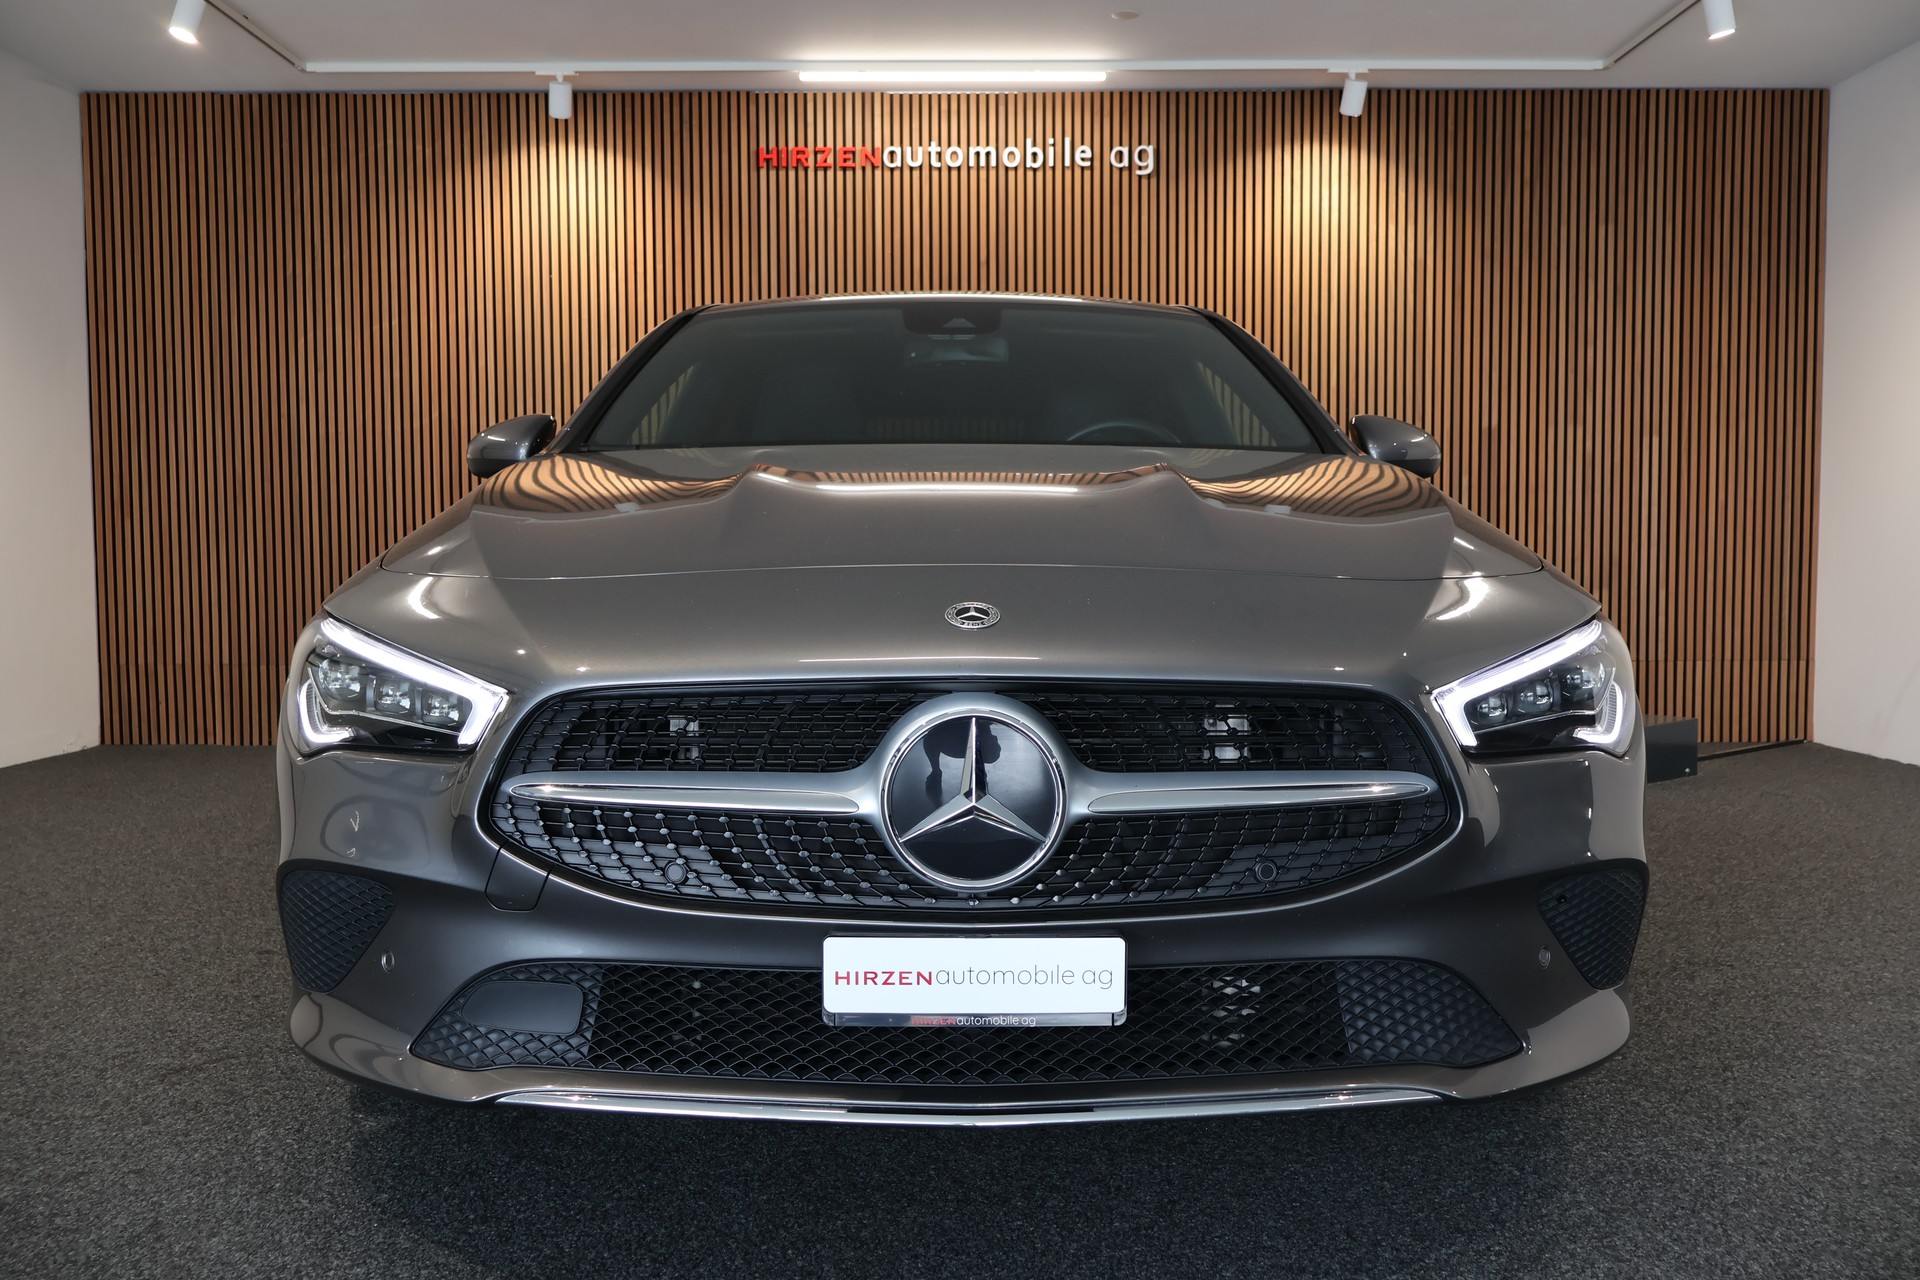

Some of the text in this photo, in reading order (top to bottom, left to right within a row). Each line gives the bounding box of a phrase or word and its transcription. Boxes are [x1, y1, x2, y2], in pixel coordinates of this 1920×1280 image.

[1110, 144, 1155, 176] ag
[1082, 969, 1113, 990] ag
[1021, 1016, 1036, 1027] ag
